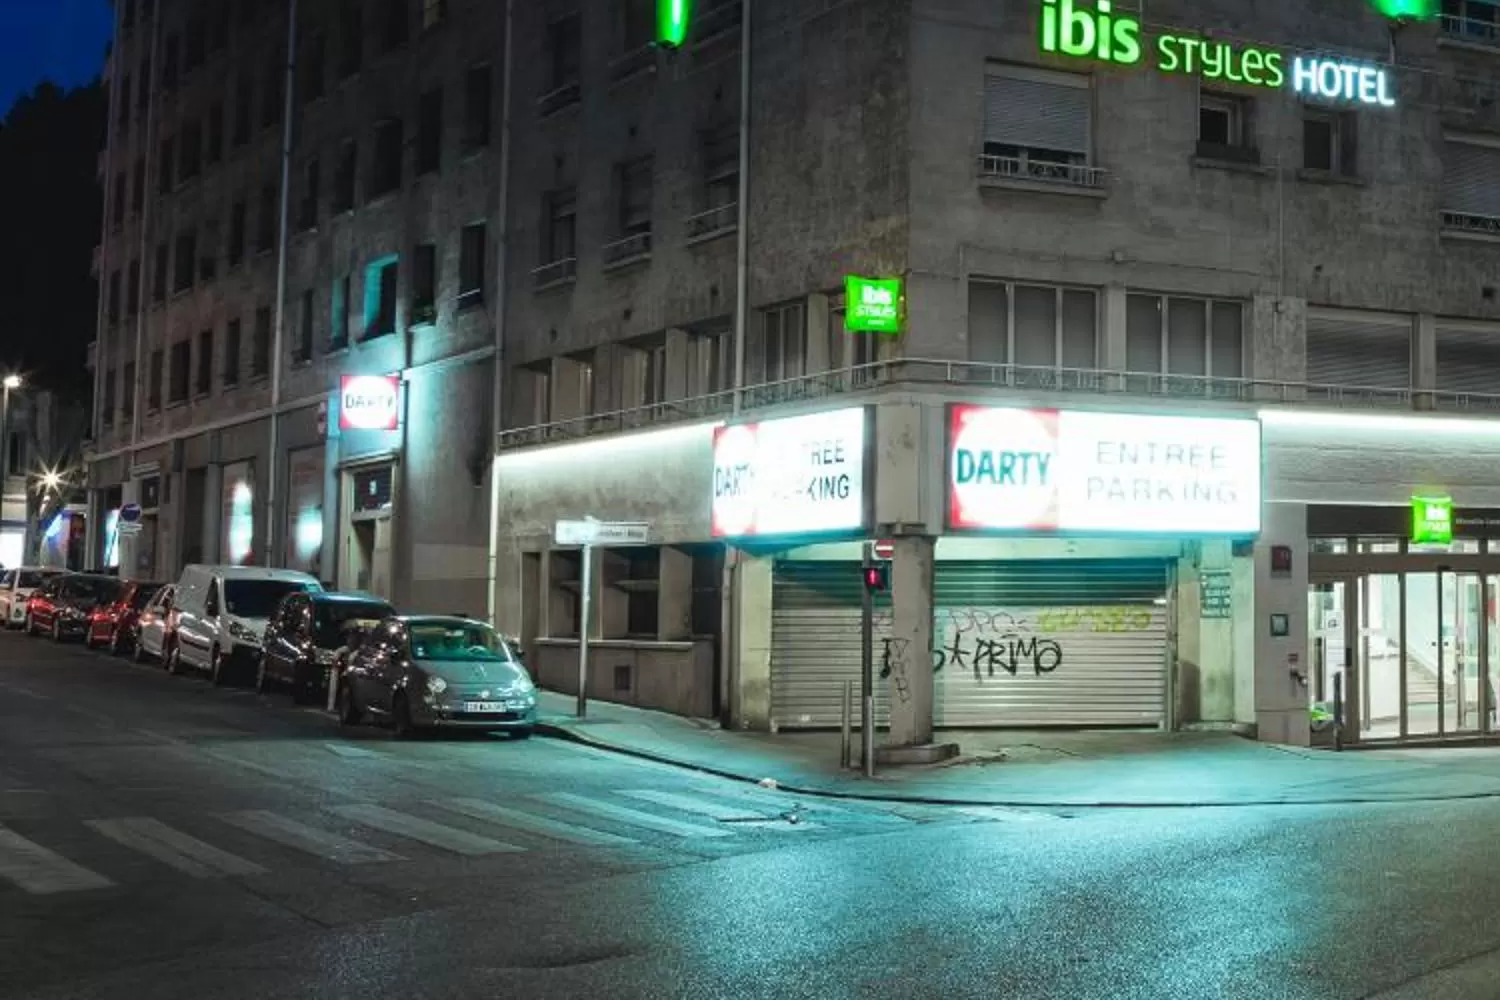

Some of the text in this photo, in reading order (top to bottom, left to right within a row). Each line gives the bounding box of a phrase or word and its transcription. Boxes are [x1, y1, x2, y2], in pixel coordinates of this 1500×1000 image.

[1293, 56, 1396, 106] HOTEL
[715, 463, 756, 497] DART
[956, 448, 1051, 486] DARTY
[1086, 475, 1239, 505] PARKING
